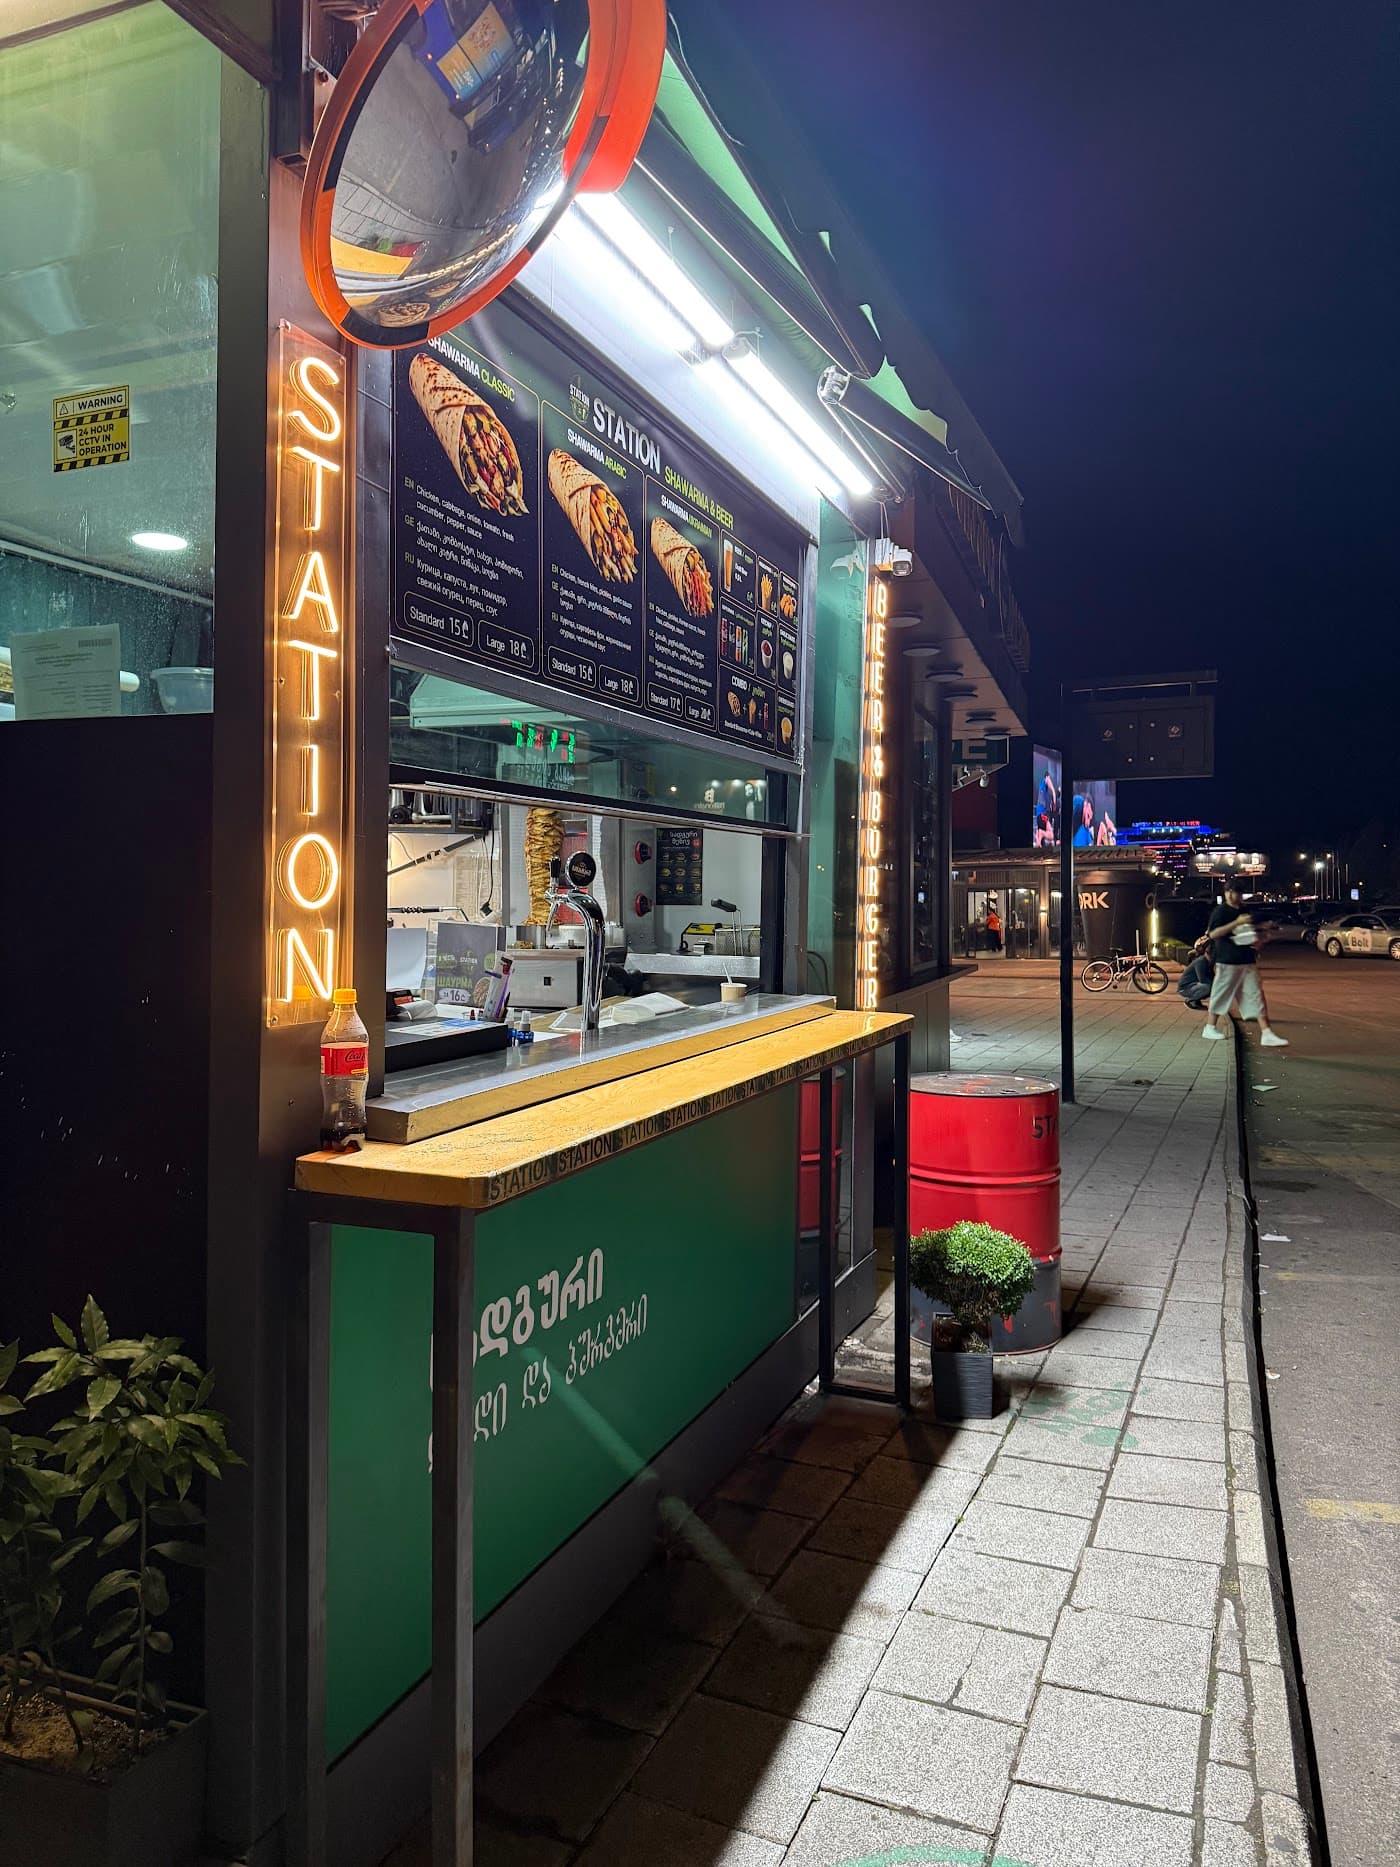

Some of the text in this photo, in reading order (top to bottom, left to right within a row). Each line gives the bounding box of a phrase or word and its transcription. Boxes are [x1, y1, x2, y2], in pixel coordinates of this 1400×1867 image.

[481, 368, 515, 402] CLASSIC
[78, 394, 123, 411] WARNING
[78, 423, 114, 437] 24 HOUR
[78, 433, 111, 447] CCTV IN
[593, 397, 661, 475] STATION
[79, 441, 127, 457] OPERATION
[567, 428, 605, 465] SHAWARMA
[404, 476, 415, 490] EN
[661, 494, 689, 523] SHAWARMA
[664, 465, 734, 531] SHAWARMA & BEER
[404, 513, 415, 527] GE
[404, 552, 415, 564] RU
[417, 558, 443, 580] Курица,
[416, 576, 441, 593] свежий
[409, 606, 446, 629] Standard
[486, 634, 505, 652] Large
[551, 657, 576, 676] Standard
[873, 582, 887, 733] BEER
[282, 355, 341, 1003] STATION
[604, 676, 619, 691] Large
[650, 691, 669, 707] Standard
[864, 790, 881, 1010] BURGER
[1351, 937, 1369, 948] Bolt
[436, 976, 473, 988] ШАУРМА
[665, 1096, 706, 1130] STATION
[618, 1114, 661, 1145] STATION
[558, 1134, 613, 1173] STATION
[489, 1154, 552, 1200] STATION
